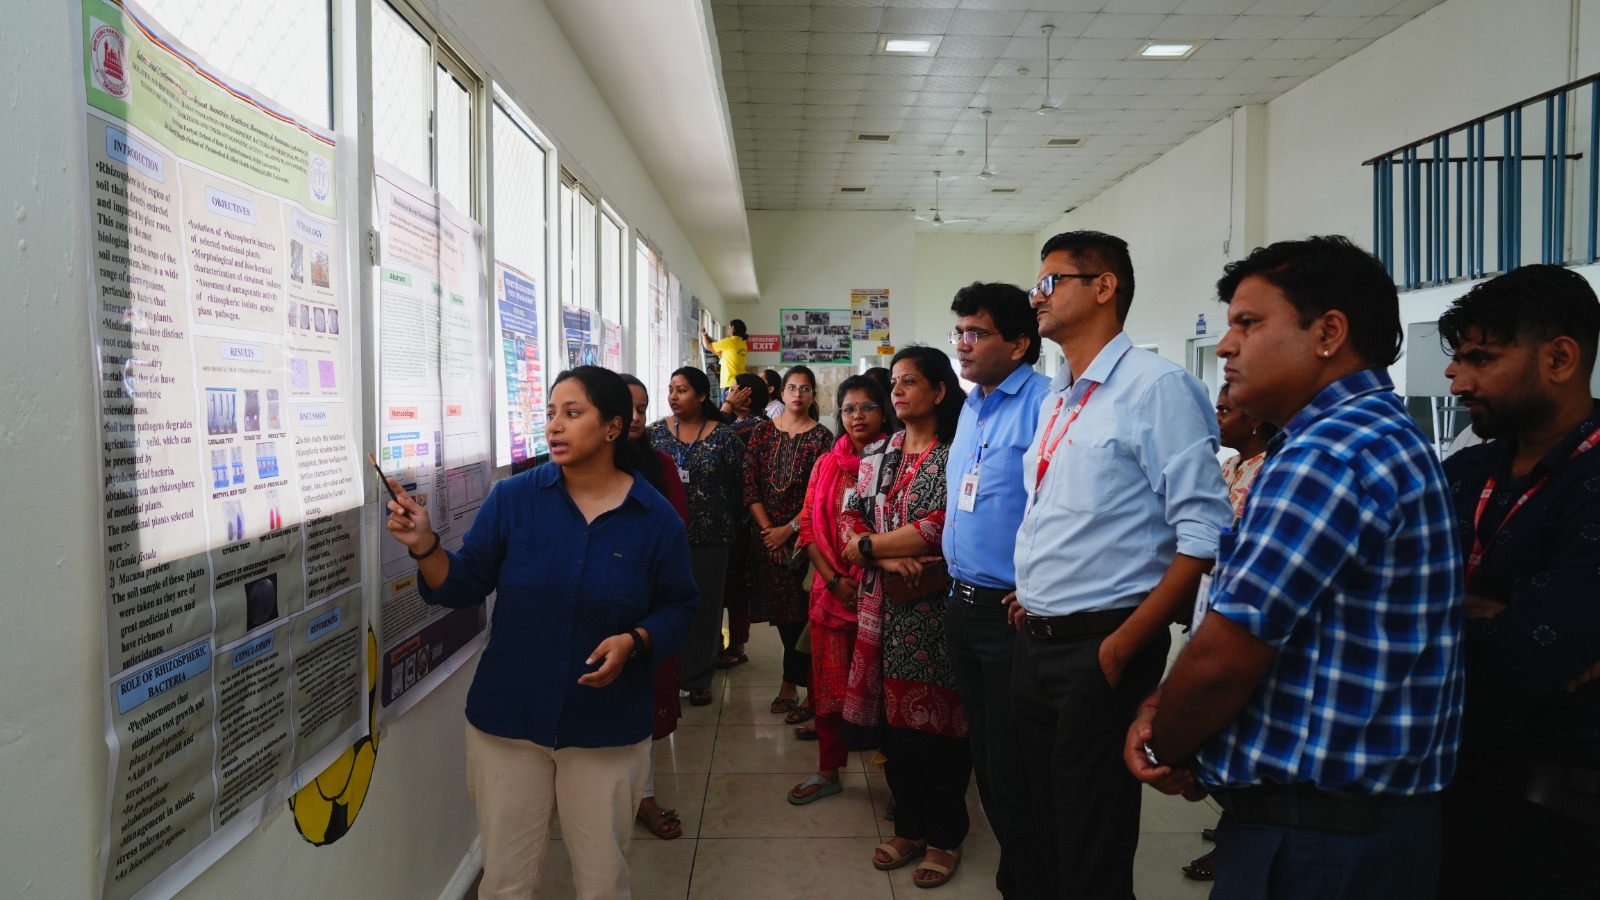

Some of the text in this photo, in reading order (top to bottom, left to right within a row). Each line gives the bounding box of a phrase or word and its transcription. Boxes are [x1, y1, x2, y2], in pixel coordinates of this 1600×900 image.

[113, 139, 159, 172] INTRODUCTION
[95, 180, 124, 197] soil that
[148, 185, 165, 200] region
[165, 193, 171, 203] of
[97, 198, 111, 209] and
[113, 200, 138, 220] impacted
[211, 196, 251, 217] OBJECTIVES
[97, 213, 113, 228] This
[115, 221, 127, 232] zone
[128, 224, 133, 234] is
[190, 235, 197, 243] of
[199, 237, 221, 249] selected
[221, 244, 245, 256] medicinal
[215, 228, 222, 236] of
[223, 230, 257, 246] rhizospheric
[98, 250, 110, 260] soil
[164, 268, 179, 279] wide
[160, 252, 166, 261] of
[167, 253, 176, 264] the
[194, 248, 233, 266] Morphological
[234, 260, 244, 268] and
[100, 268, 126, 281] range of
[193, 262, 236, 280] characterization
[237, 272, 243, 281] of
[226, 283, 232, 292] of
[153, 296, 166, 307] that
[195, 292, 203, 300] of
[207, 293, 240, 307] rhizospheric
[241, 300, 258, 310] isolates
[153, 312, 173, 323] plants.
[197, 305, 213, 317] plant
[105, 318, 184, 339] Medicinal have distinct
[102, 337, 160, 352] root exudates that are
[229, 347, 255, 358] RESULTS
[752, 342, 775, 350] EXIT
[160, 374, 175, 383] have
[103, 404, 133, 415] microbial
[106, 419, 192, 433] Soil borne pathogens degrades
[104, 435, 192, 453] agricultural which can
[104, 453, 152, 469] be prevented by
[150, 466, 175, 478] bacteria
[105, 479, 195, 502] obtained from the rhizosphere
[106, 500, 163, 519] of medicinal plants.
[107, 508, 194, 536] The medicinal plants selected
[108, 543, 123, 553] were
[221, 542, 251, 555] CITRATE TEST
[116, 548, 157, 568] Cassia fistula
[119, 572, 145, 585] Mucuna
[236, 567, 243, 575] OF
[112, 567, 205, 605] The soil sample of these plants
[119, 583, 196, 619] were taken as they are of
[120, 599, 196, 638] great medicinal uses and
[121, 623, 173, 653] have richness of
[234, 637, 272, 663] CONCLUSION
[120, 644, 208, 695] ROLE OF RHIZOSPHERIC
[148, 672, 186, 698] BACTERIA
[130, 691, 189, 733] Phytohormones that
[131, 696, 205, 751] stimulates root growth and
[183, 732, 194, 747] and
[128, 750, 148, 771] plant
[125, 775, 158, 801] structure.
[123, 791, 195, 846] Management in abiotic
[115, 824, 173, 867] stress tolerance.
